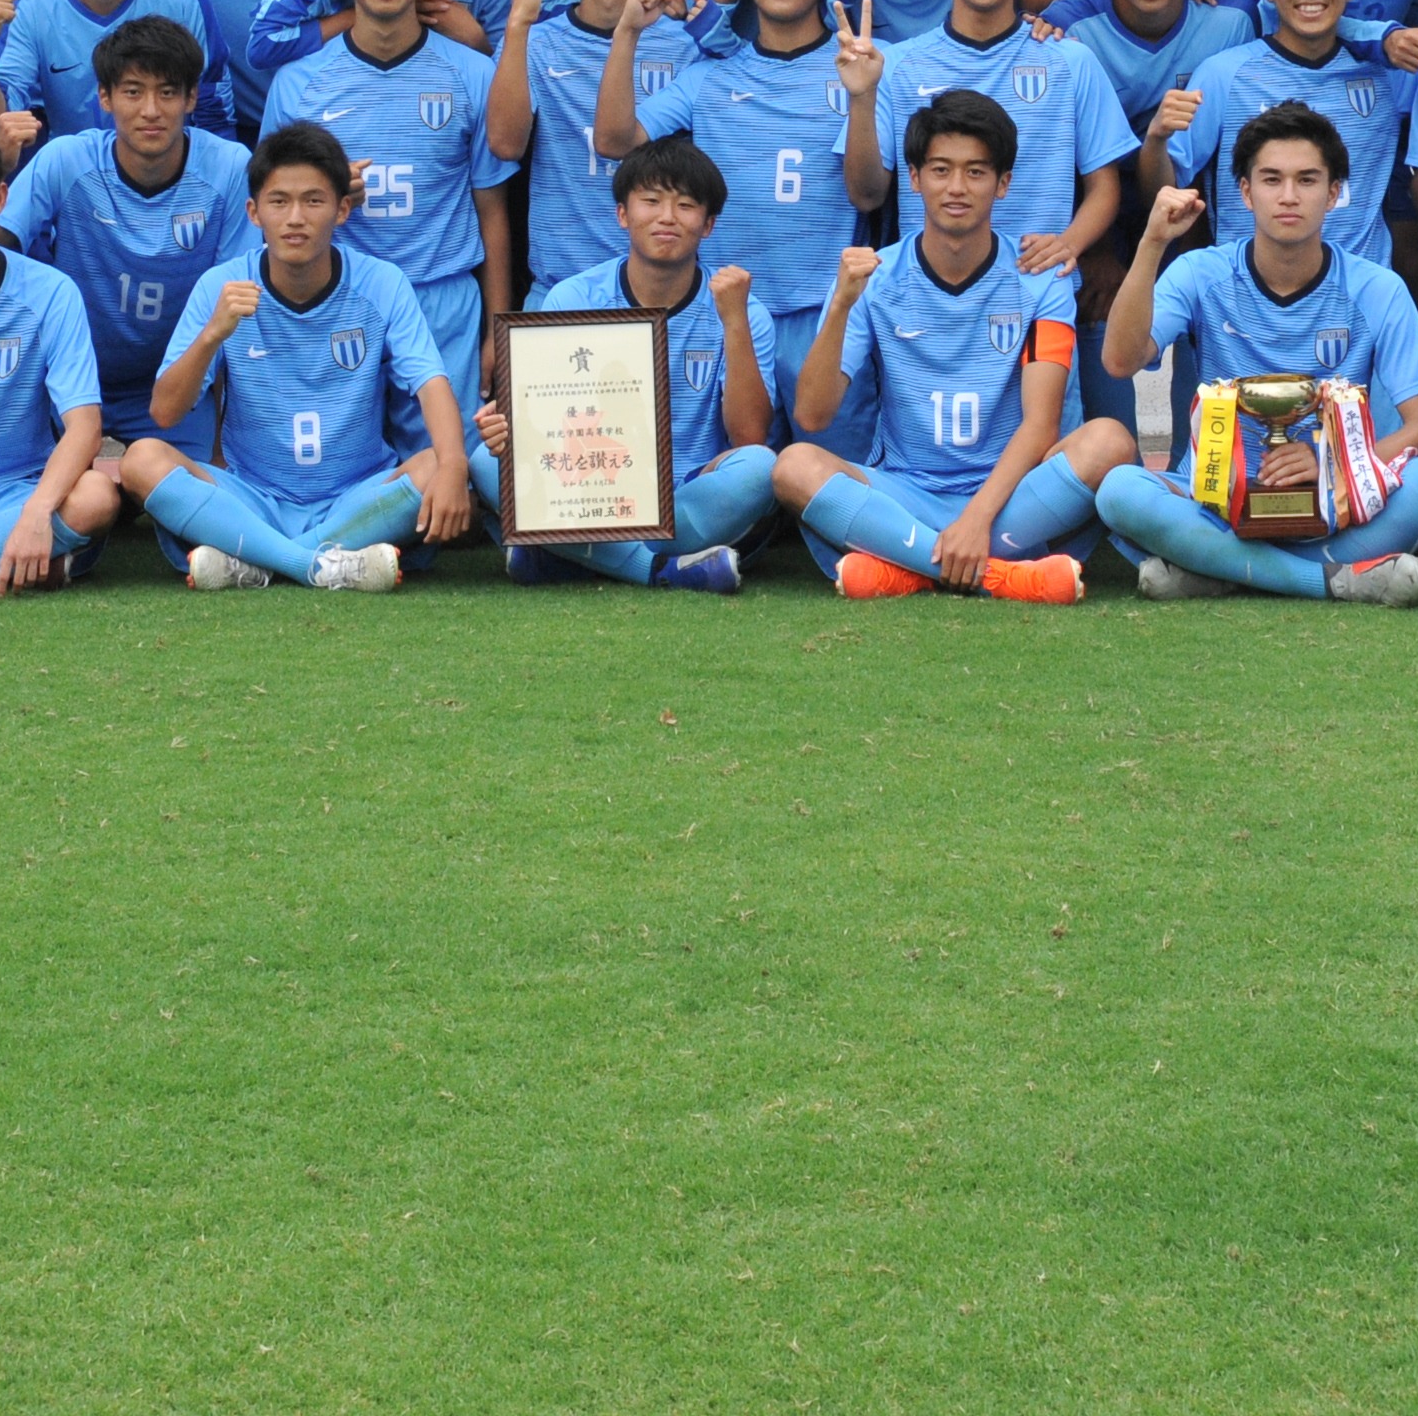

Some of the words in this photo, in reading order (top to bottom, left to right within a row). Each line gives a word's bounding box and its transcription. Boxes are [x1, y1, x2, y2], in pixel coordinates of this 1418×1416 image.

[362, 165, 414, 217] 25
[774, 149, 802, 203] 6
[118, 273, 165, 322] 18
[569, 346, 594, 374] 賞
[293, 411, 323, 464] 8
[929, 392, 980, 446] 10
